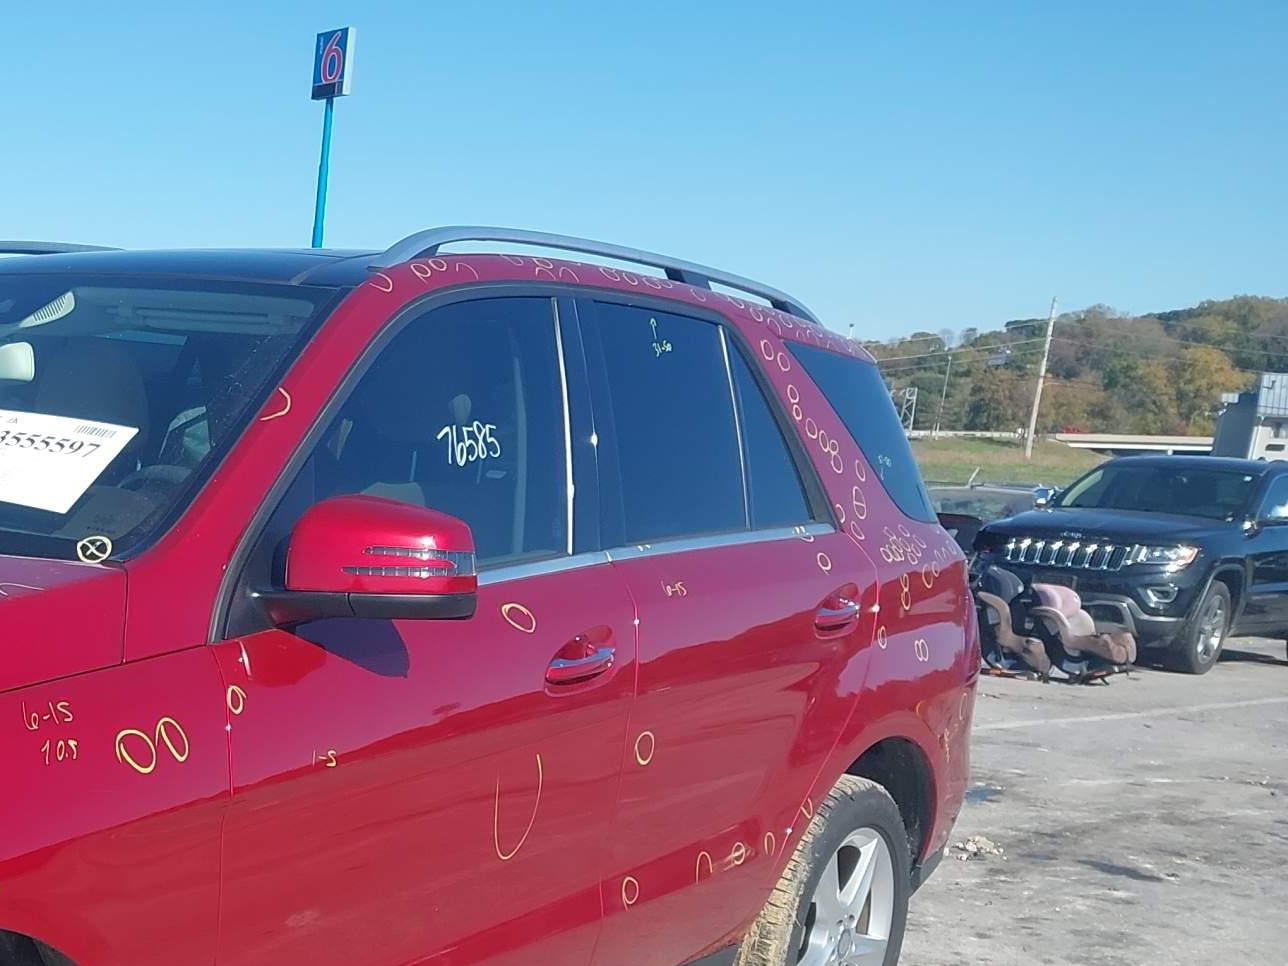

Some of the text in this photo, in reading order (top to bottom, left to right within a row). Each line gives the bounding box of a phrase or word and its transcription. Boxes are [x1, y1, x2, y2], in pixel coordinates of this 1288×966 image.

[321, 31, 343, 84] 6
[437, 421, 501, 467] 76585
[22, 701, 73, 730] 6-15
